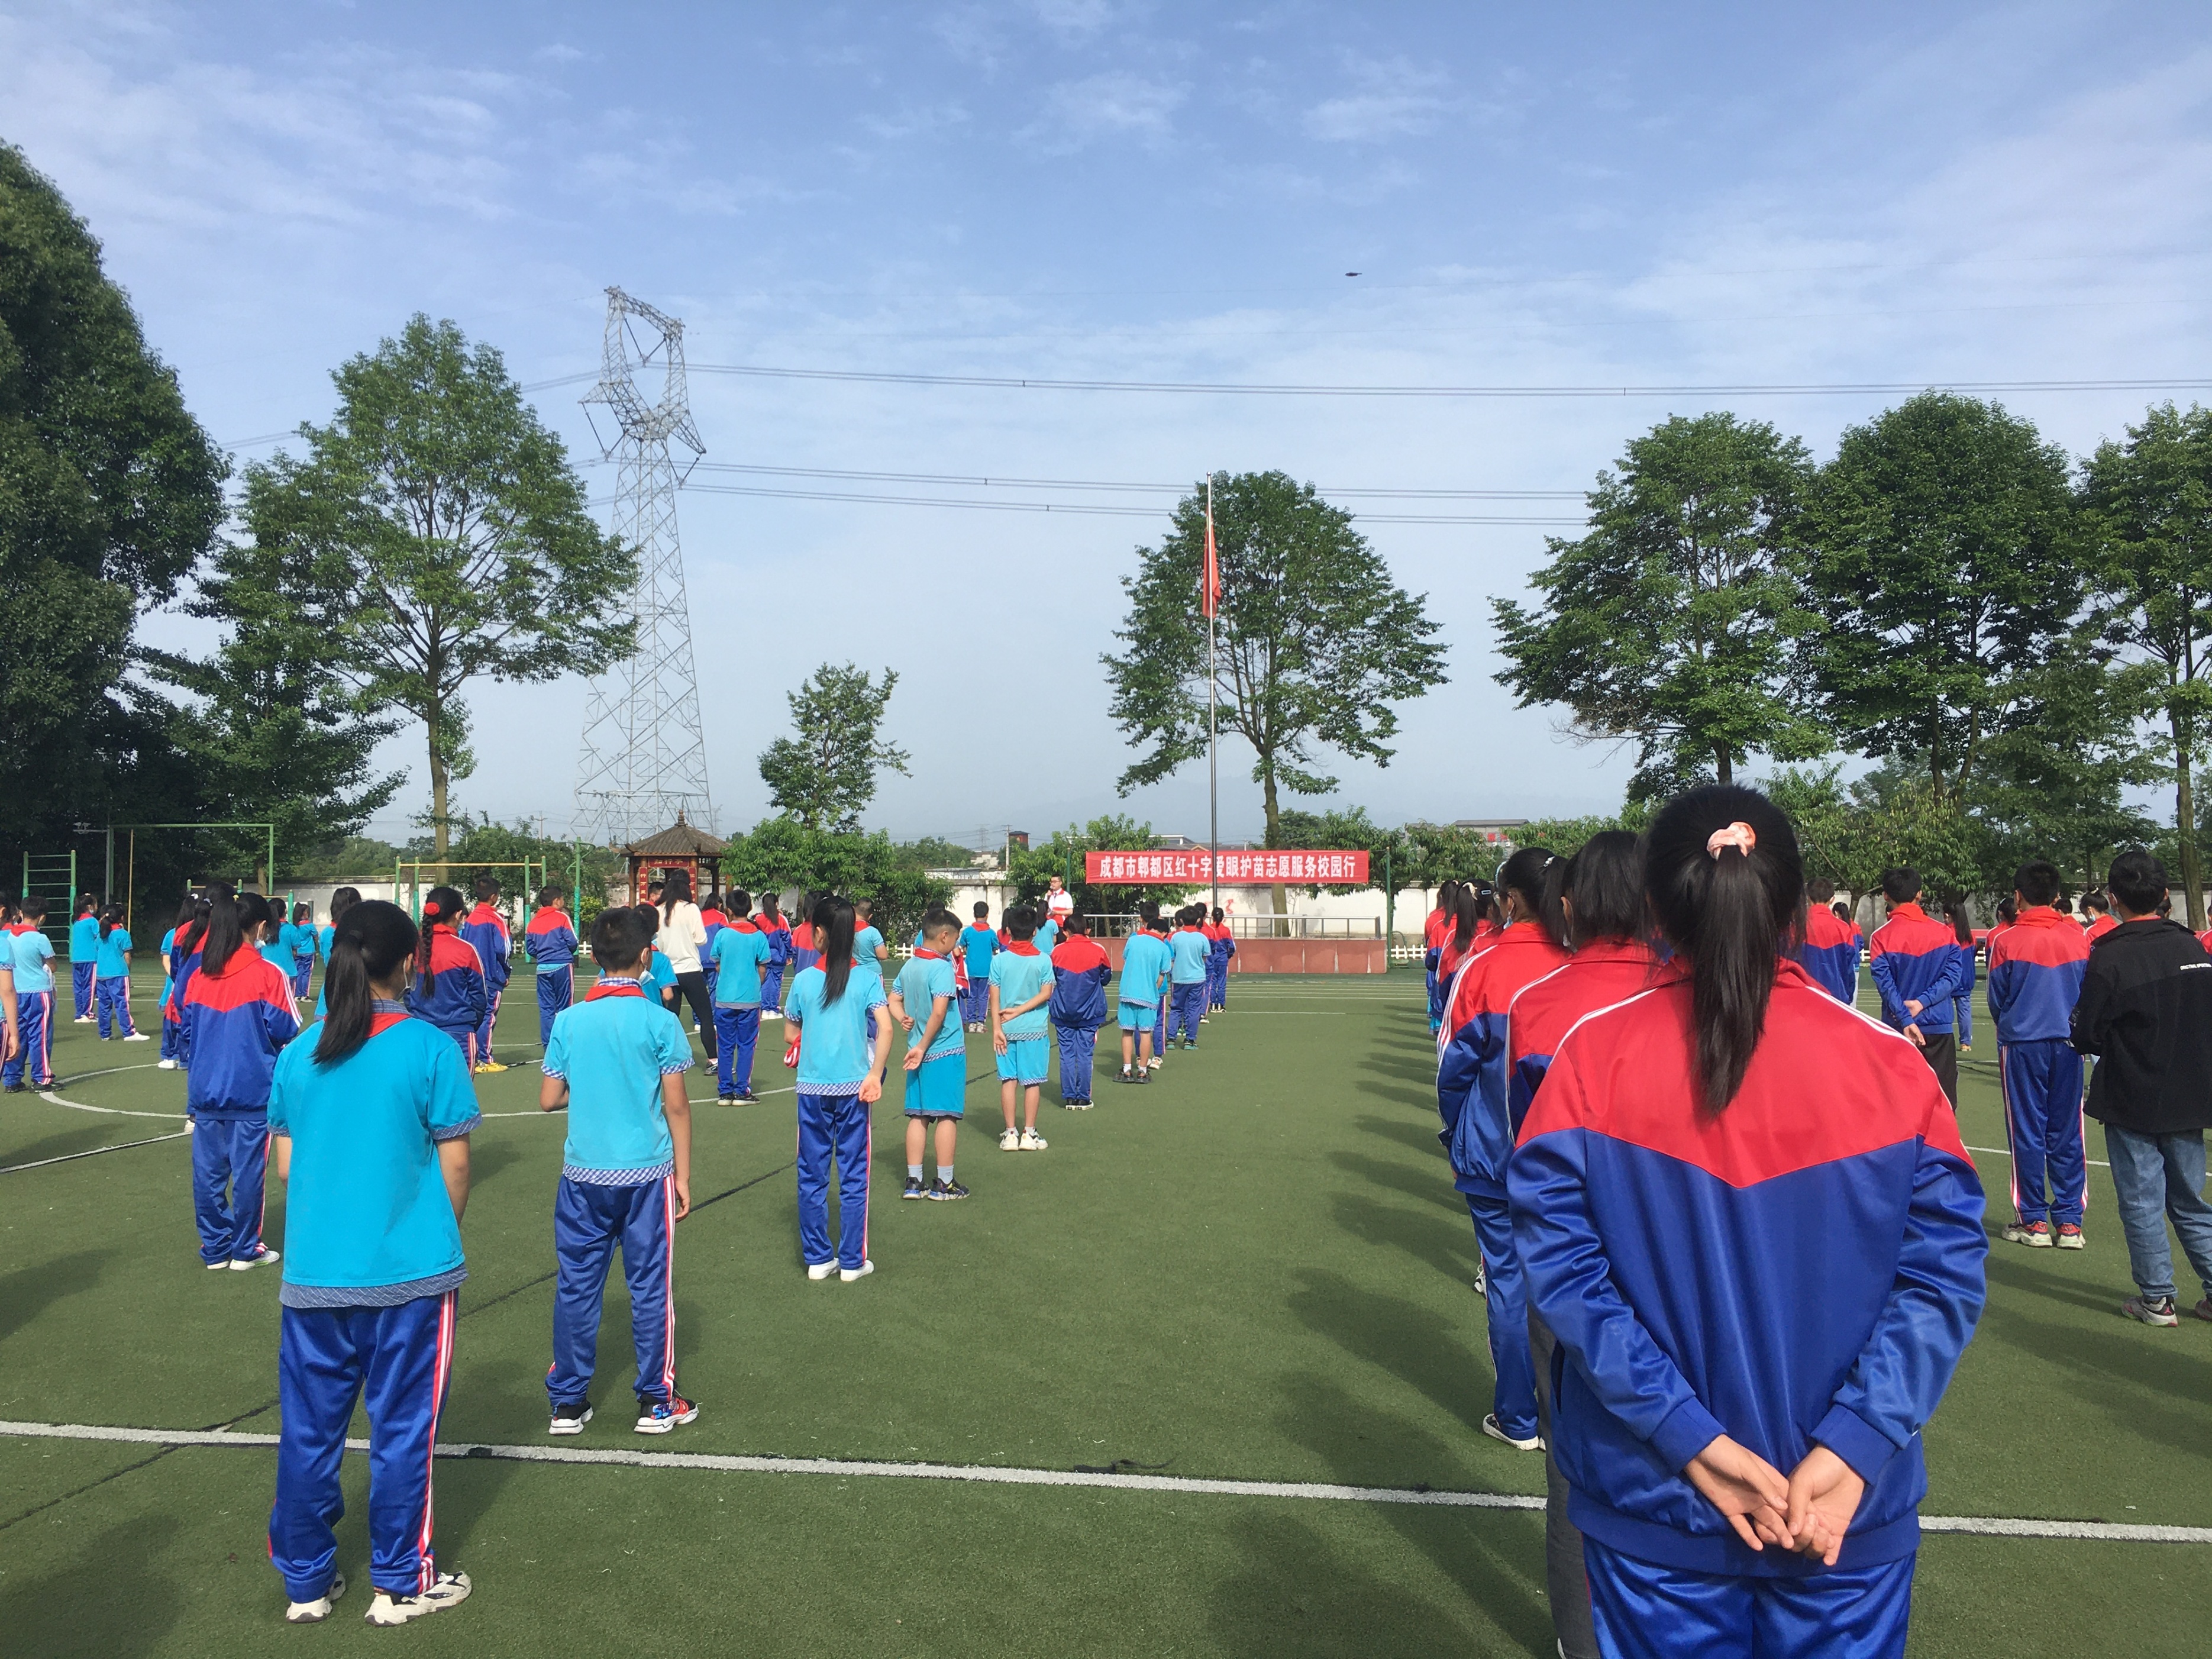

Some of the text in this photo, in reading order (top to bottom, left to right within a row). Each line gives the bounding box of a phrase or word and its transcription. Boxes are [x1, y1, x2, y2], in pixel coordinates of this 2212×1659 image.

[1100, 855, 1356, 878] 成都市郫都区红十字爱眼护苗志愿服务校园行
